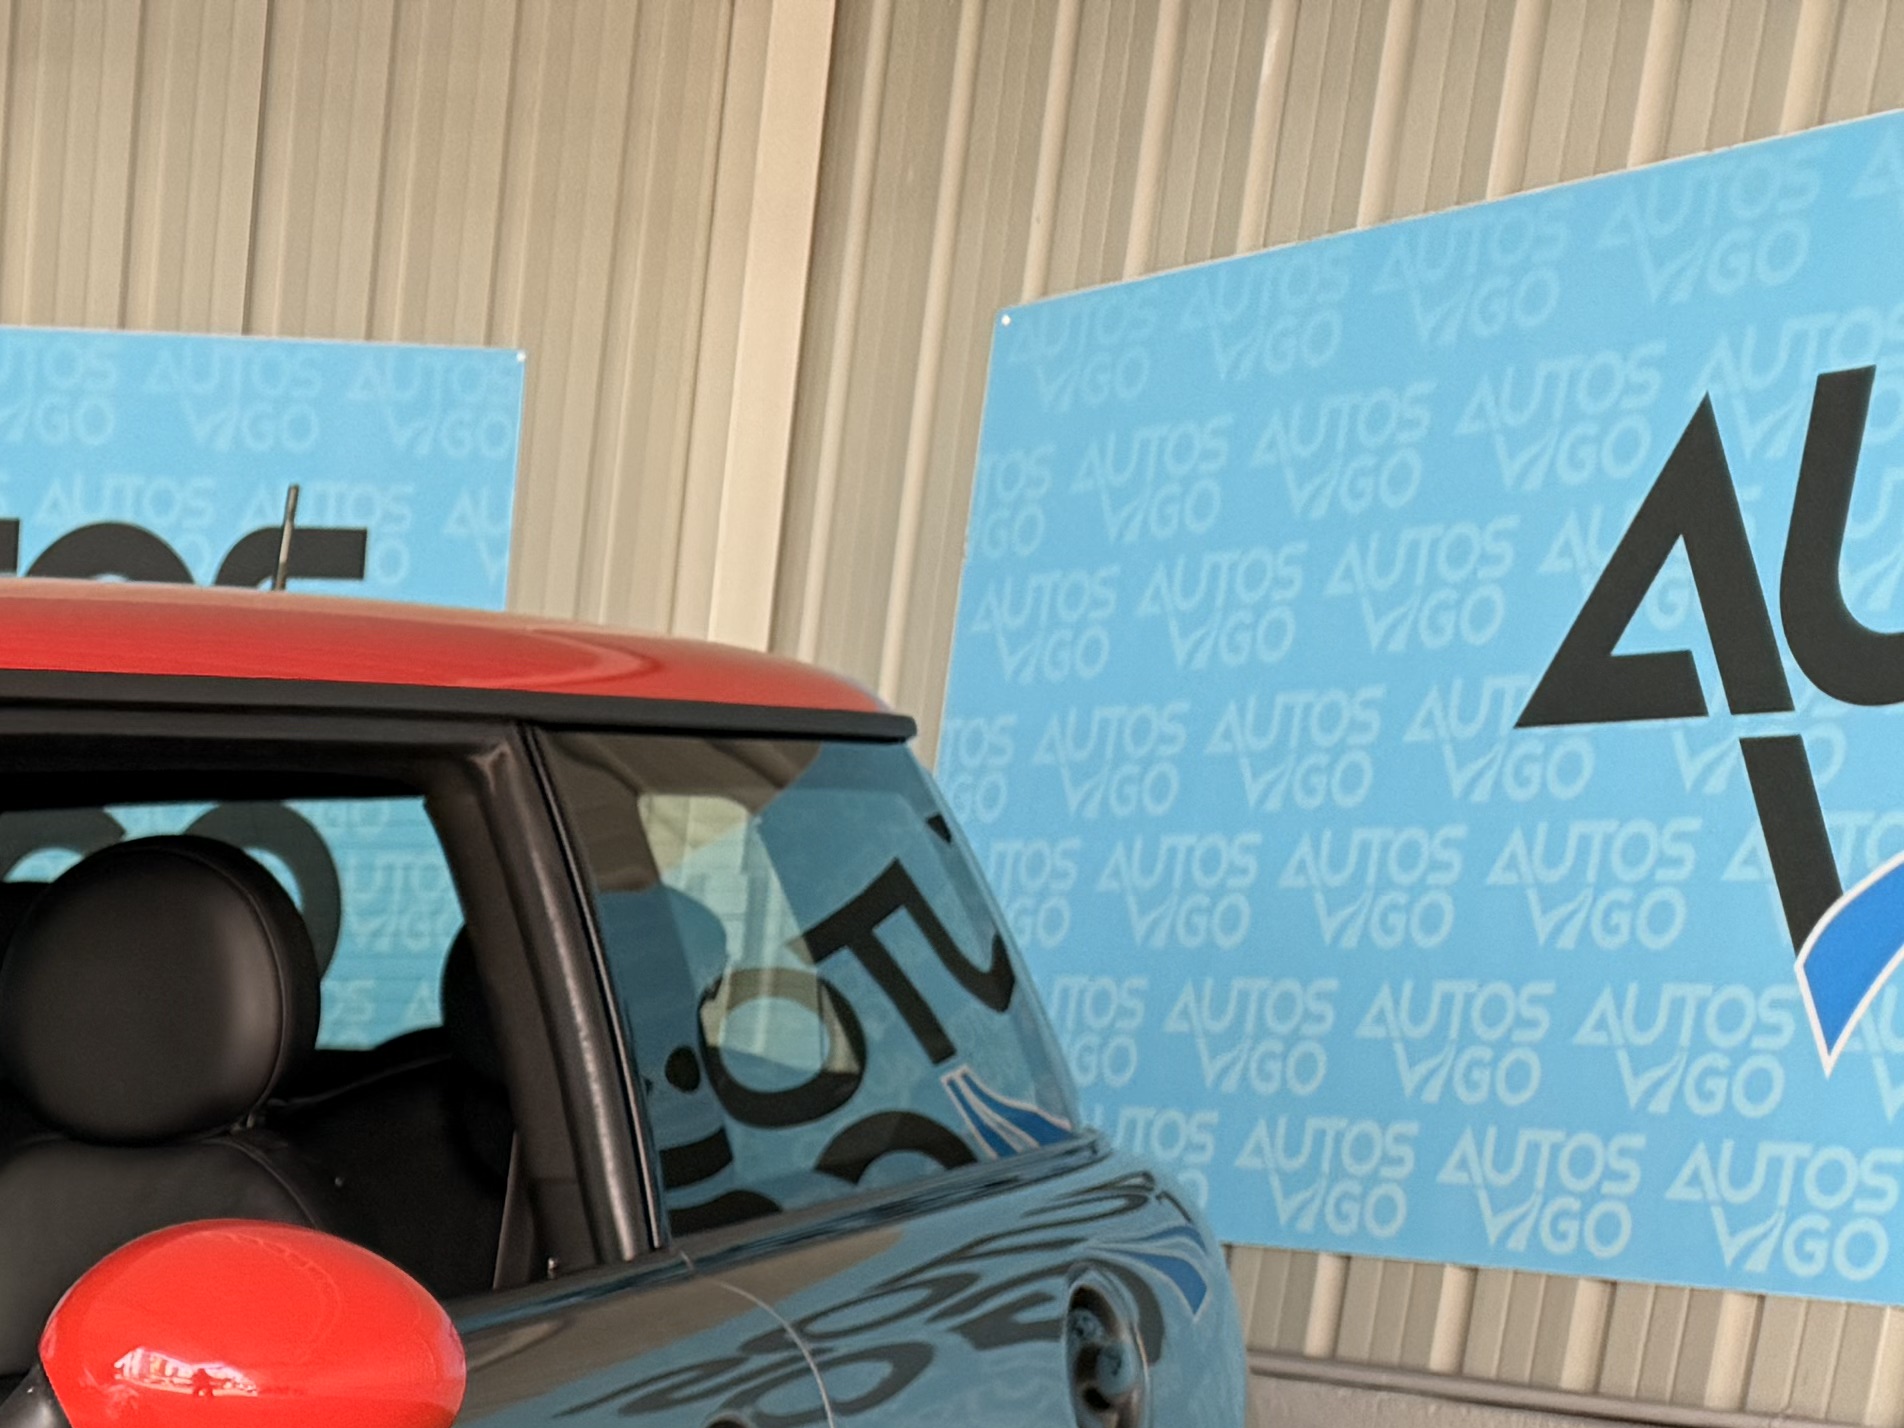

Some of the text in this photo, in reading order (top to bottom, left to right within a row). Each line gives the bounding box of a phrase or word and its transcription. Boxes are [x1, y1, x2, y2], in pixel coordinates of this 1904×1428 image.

[1250, 378, 1438, 468] AUTOS
[1453, 340, 1668, 437] AUTOS
[1070, 411, 1235, 494] AUTOS
[1134, 539, 1309, 618] AUTOS
[1322, 514, 1521, 597] AUTOS
[970, 562, 1121, 633] AUTOS
[1032, 699, 1191, 767] AUTOS
[1202, 682, 1388, 757] AUTOS
[1096, 830, 1263, 893] AUTOS
[1278, 823, 1469, 889] AUTOS
[1485, 816, 1704, 888] AUTOS
[1162, 975, 1341, 1038] AUTOS
[1353, 978, 1557, 1045] AUTOS
[1571, 979, 1800, 1051] AUTOS
[1234, 1113, 1420, 1181] AUTOS
[1435, 1124, 1647, 1196] AUTOS
[1664, 1137, 1904, 1215] AUTOS
